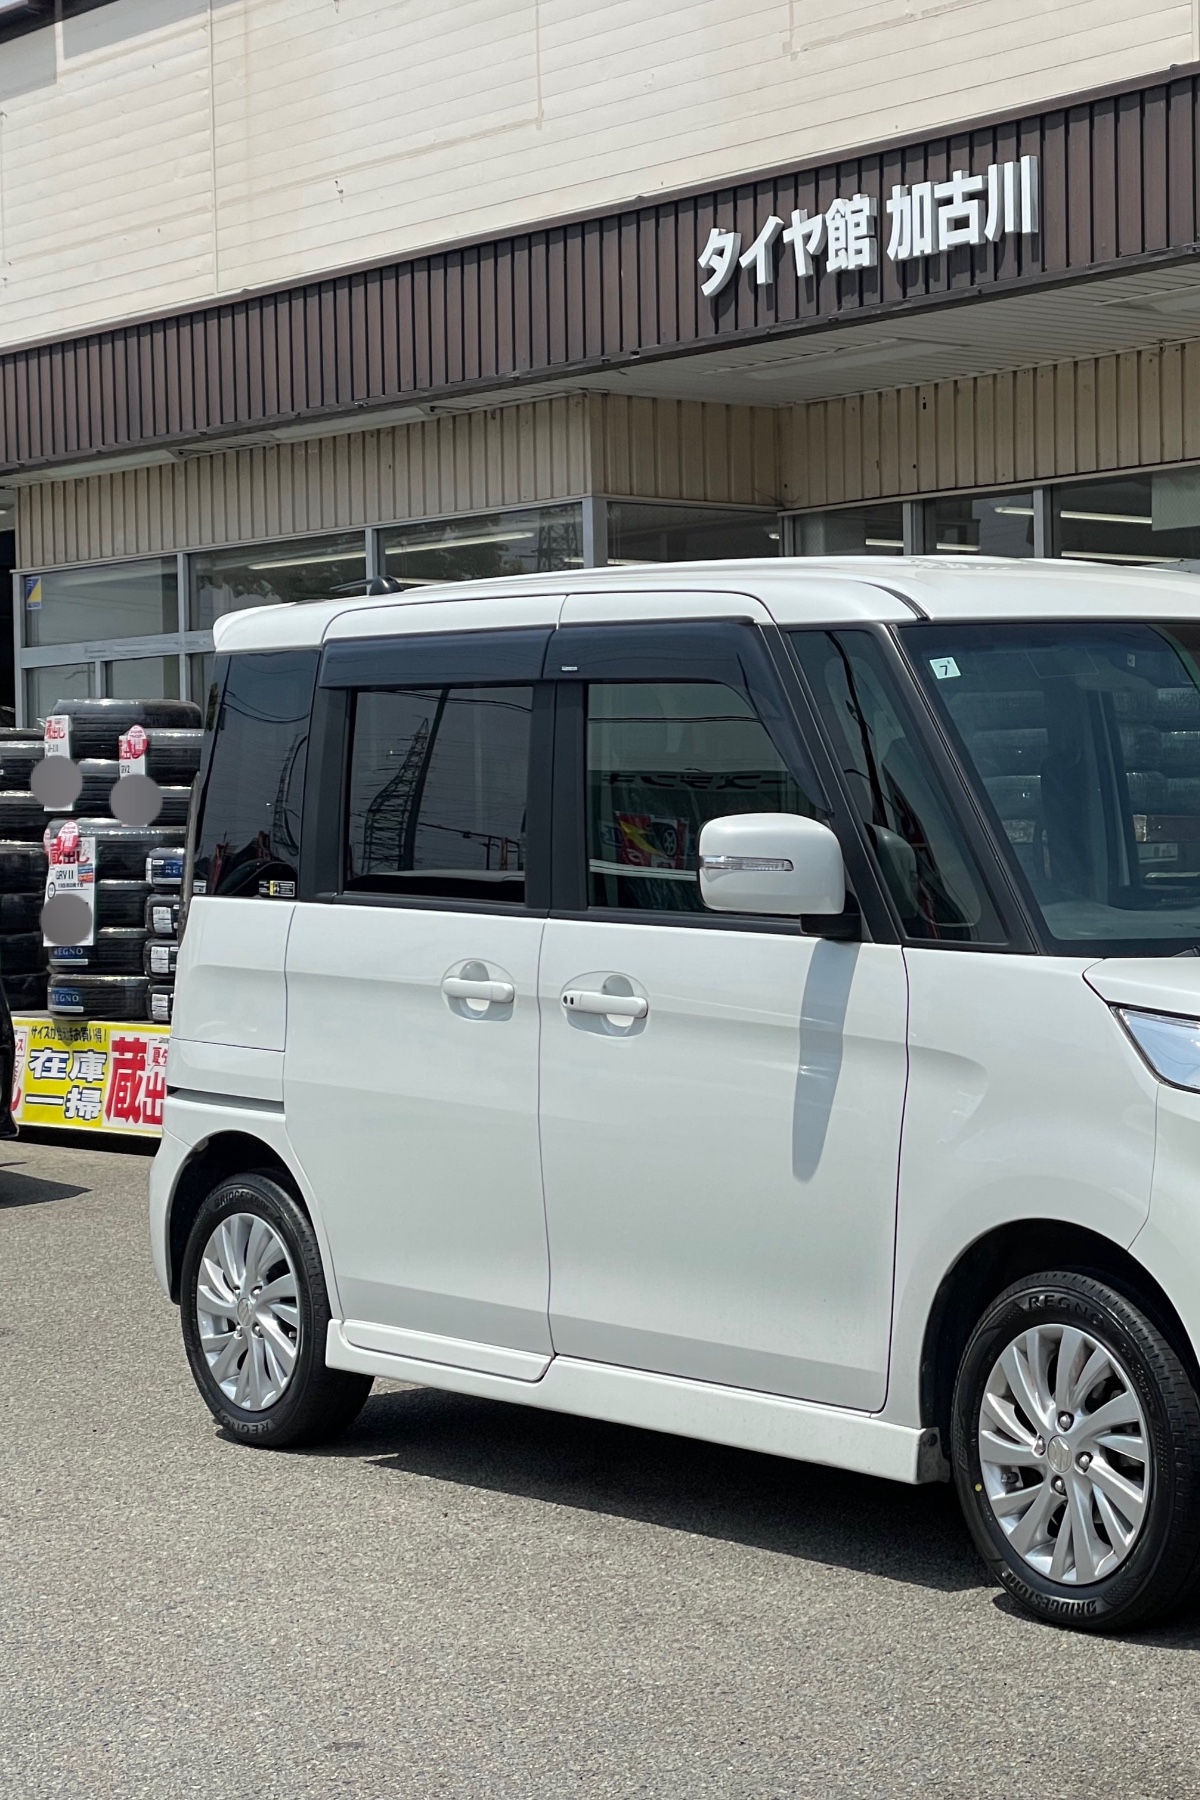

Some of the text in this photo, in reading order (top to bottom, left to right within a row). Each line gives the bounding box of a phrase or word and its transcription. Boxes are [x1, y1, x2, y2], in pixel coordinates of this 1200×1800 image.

[698, 155, 1039, 296] タイヤ館 加古川
[28, 1047, 107, 1082] 在庫
[25, 1085, 102, 1120] 一掃
[1028, 1295, 1104, 1328] REGNO
[1002, 1568, 1097, 1615] BRIDGESTONE
